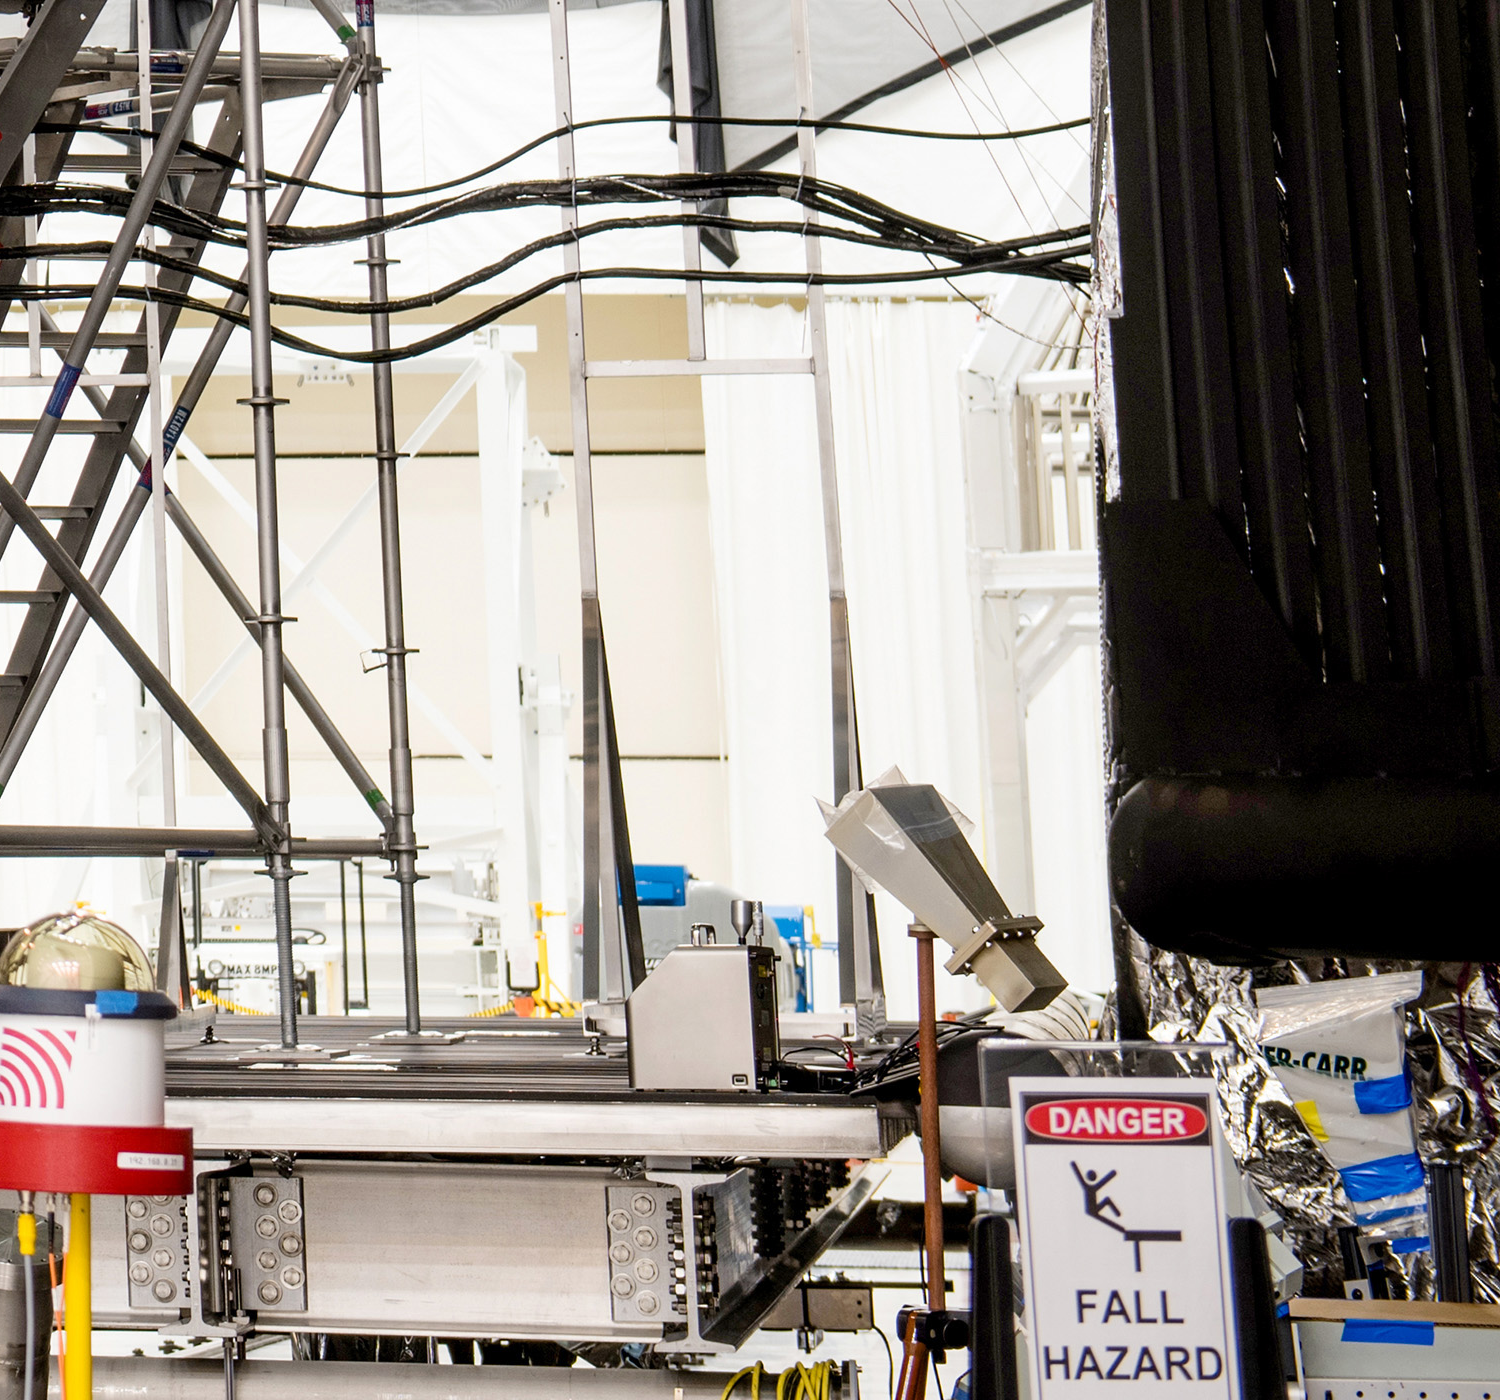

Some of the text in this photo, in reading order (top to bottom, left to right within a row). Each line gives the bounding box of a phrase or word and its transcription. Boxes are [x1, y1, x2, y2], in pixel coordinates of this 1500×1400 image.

[227, 964, 278, 975] MAX 8MP
[1048, 1106, 1187, 1137] DANGER
[1076, 1289, 1185, 1325] FALL
[1044, 1345, 1224, 1382] HAZARD
